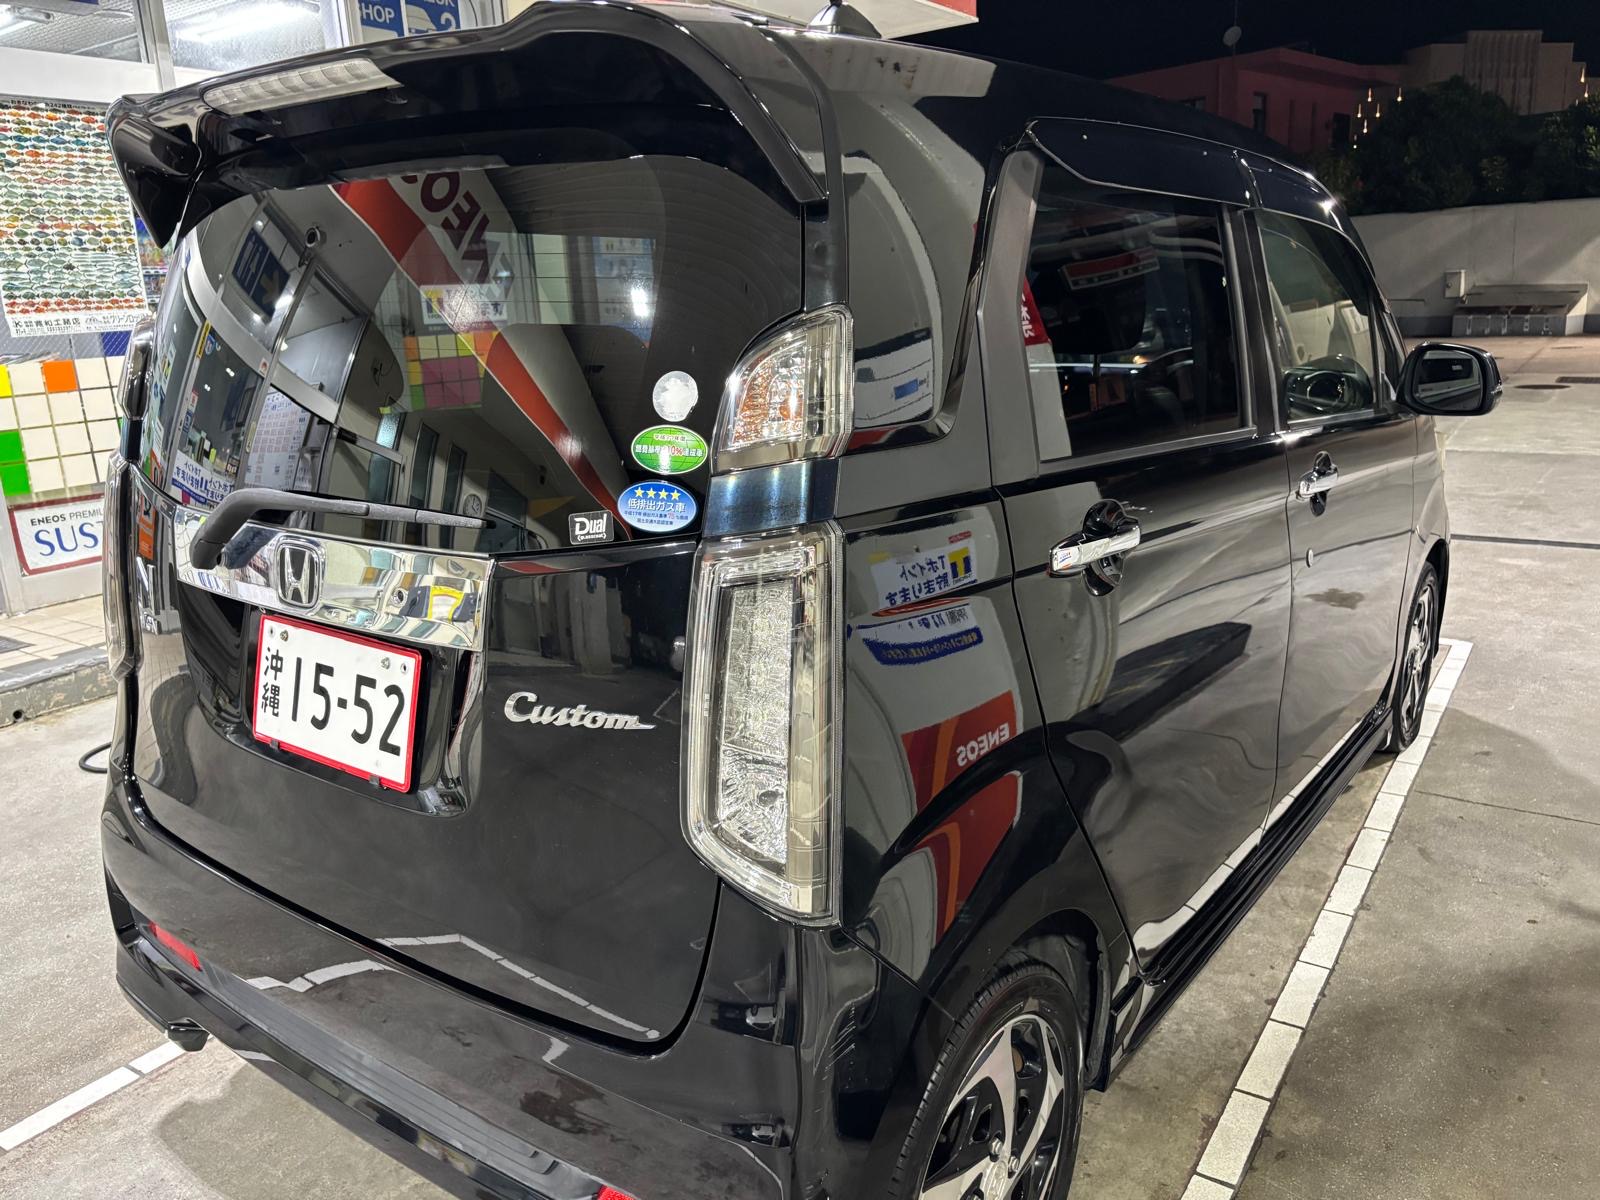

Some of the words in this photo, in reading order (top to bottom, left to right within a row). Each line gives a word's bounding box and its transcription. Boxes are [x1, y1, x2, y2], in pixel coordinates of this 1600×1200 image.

[30, 513, 67, 526] ENEOS
[628, 498, 687, 513] 低排出ガス車
[573, 513, 608, 536] Dual
[261, 647, 284, 718] 沖縄
[291, 656, 405, 757] 15-52
[504, 691, 656, 730] Custom
